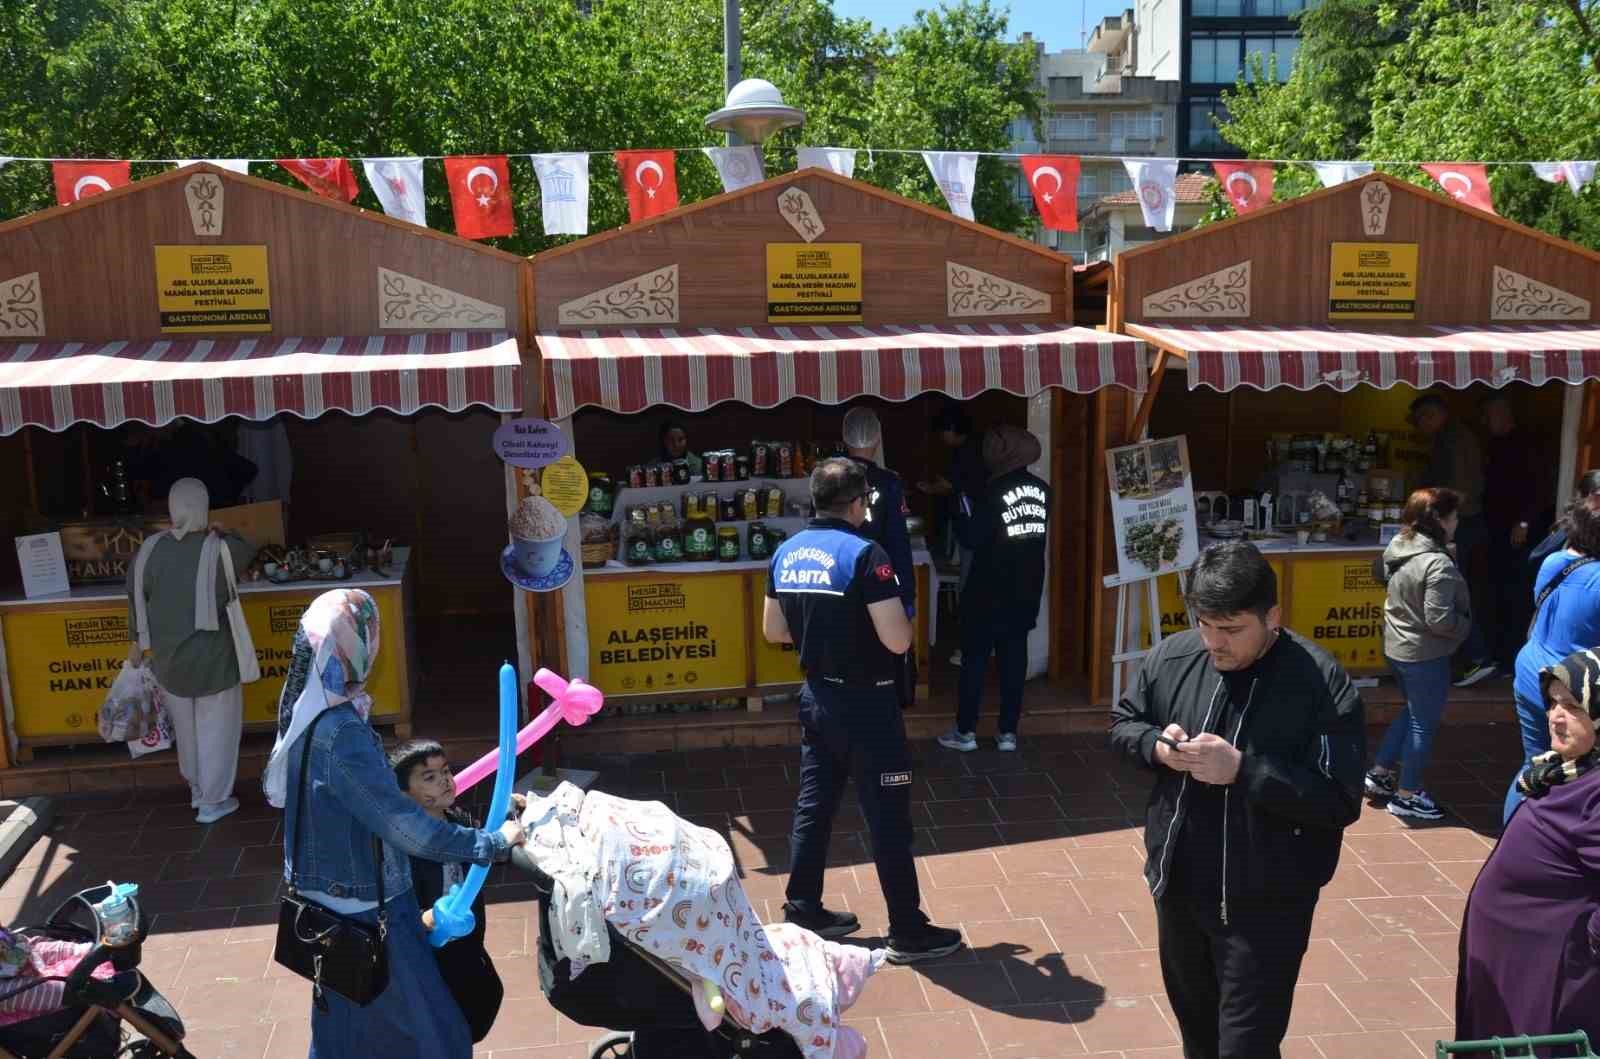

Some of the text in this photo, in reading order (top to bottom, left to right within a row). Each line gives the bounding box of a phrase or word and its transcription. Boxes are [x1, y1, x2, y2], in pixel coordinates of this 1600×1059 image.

[191, 278, 254, 286] ULUSLARARASI
[164, 287, 263, 297] MANİSA MESİR MACUNU
[194, 296, 236, 306] FESTİVALİ
[168, 312, 266, 323] GASTRONOMİ ARENASI
[783, 545, 835, 570] BÜYÜKŞEHİR
[781, 569, 832, 585] ZABITA
[1326, 602, 1384, 621] AKHİS
[607, 621, 709, 645] ALAŞEHİR
[600, 640, 717, 664] BELEDİYESİ
[49, 658, 101, 674] Cilveli
[49, 677, 92, 692] HAN
[884, 774, 909, 784] ZABITA
